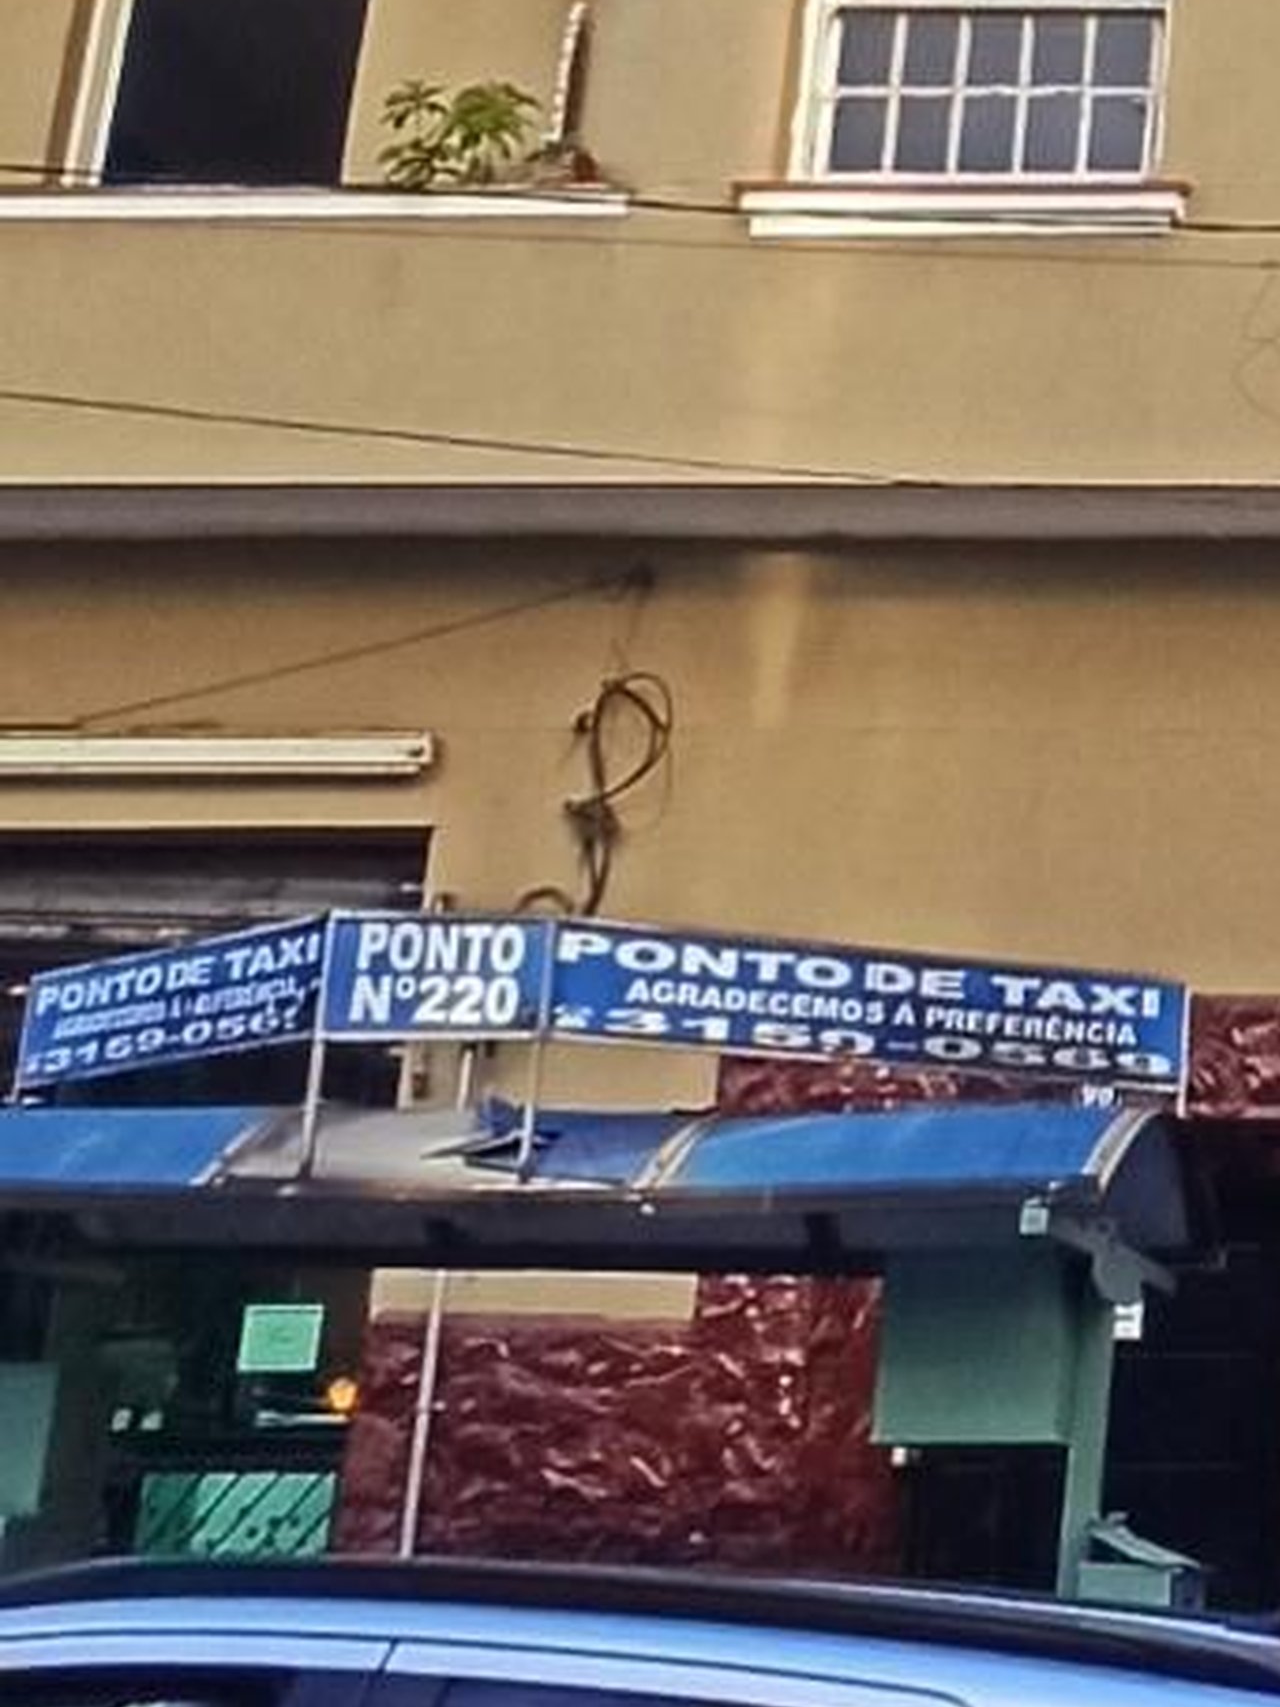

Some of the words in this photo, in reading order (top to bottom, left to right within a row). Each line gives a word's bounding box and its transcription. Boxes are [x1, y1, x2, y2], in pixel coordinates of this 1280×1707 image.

[36, 967, 162, 1014] PONTO
[167, 956, 215, 992] DE
[224, 932, 320, 979] TAXI
[356, 922, 525, 973] PONTO
[557, 930, 850, 989] PONTO
[865, 961, 966, 1000] DE
[991, 974, 1161, 1019] TAXI
[626, 978, 885, 1024] AGRADECEMOS
[925, 1006, 1138, 1045] PREFERÊNCIA
